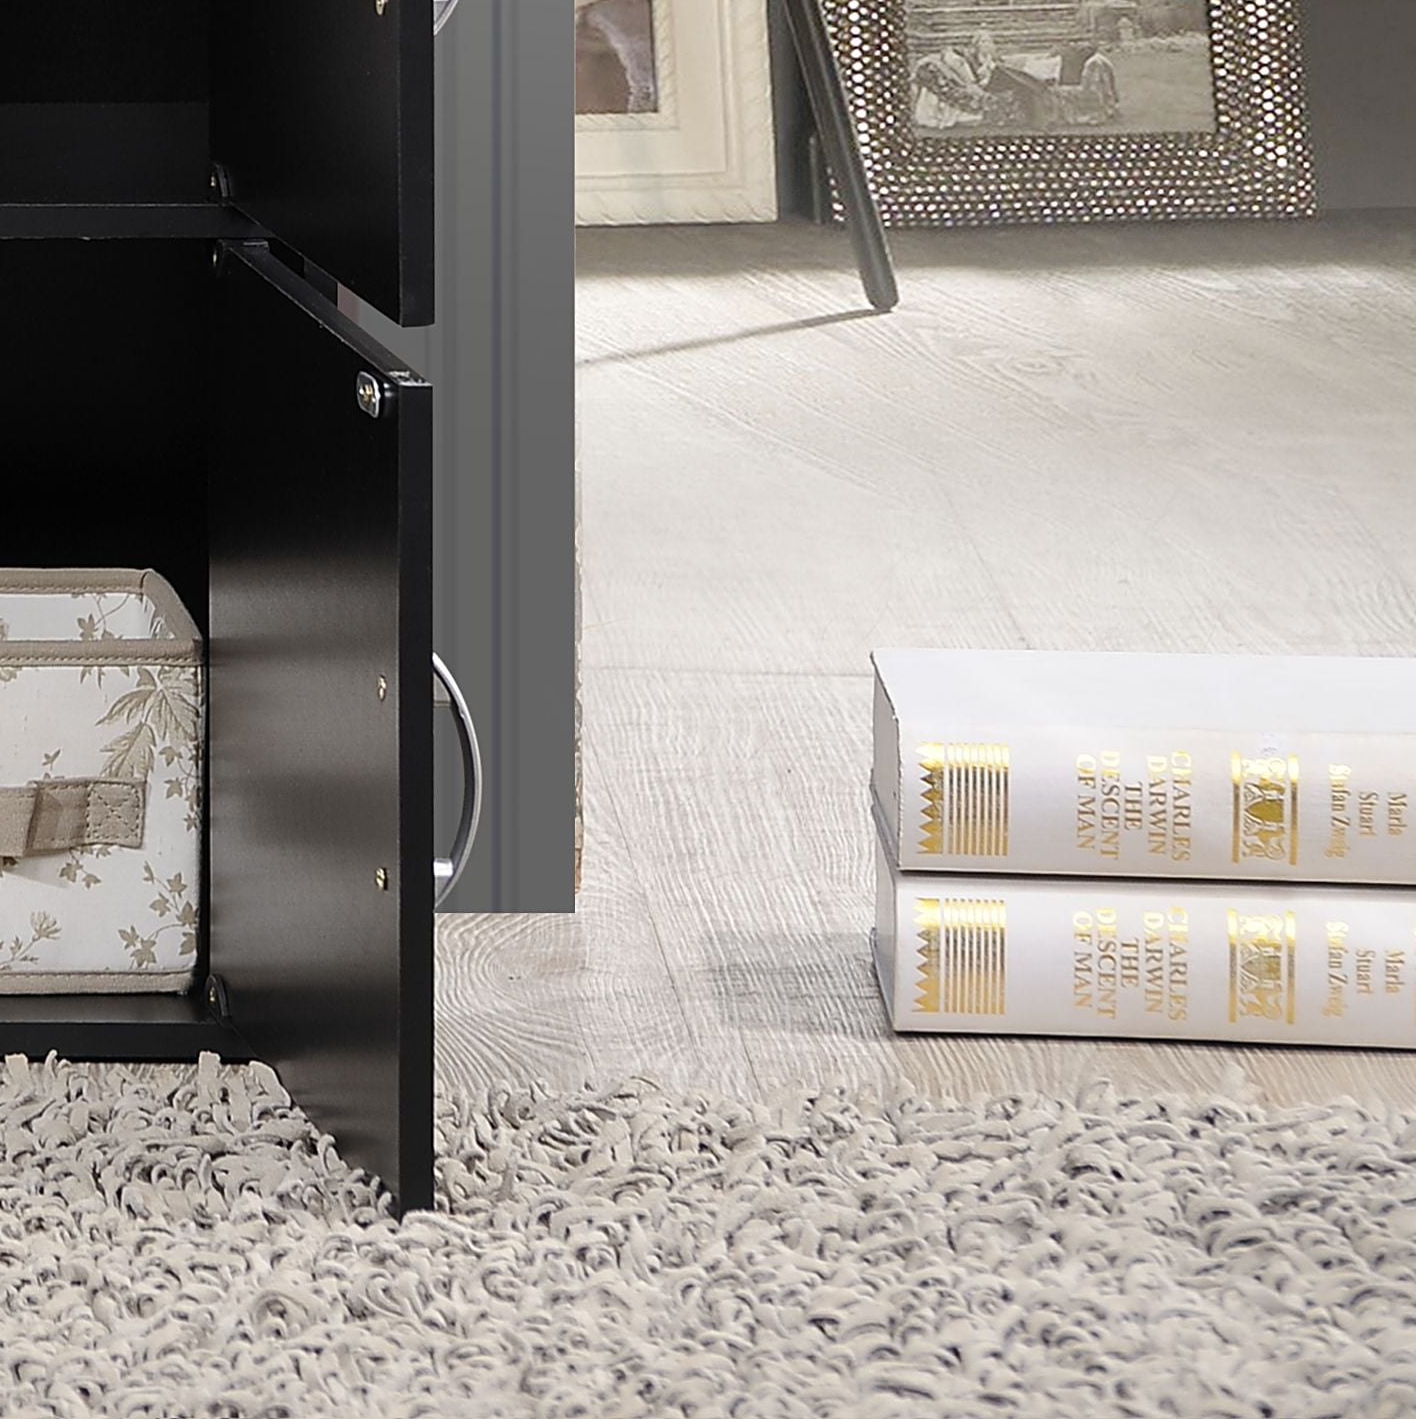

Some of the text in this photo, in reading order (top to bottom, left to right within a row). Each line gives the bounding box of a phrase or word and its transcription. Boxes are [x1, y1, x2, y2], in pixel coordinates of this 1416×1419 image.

[1076, 754, 1096, 850] OF MAN
[1100, 750, 1120, 861] DESCENT
[1124, 780, 1143, 831] THE
[1146, 755, 1167, 856] DARWIN
[1171, 749, 1192, 861] CHARLES
[1358, 790, 1379, 837] Stuart
[1073, 910, 1093, 1008] OF MAN
[1095, 906, 1116, 1019] DESCENT
[1120, 937, 1140, 989] THE
[1144, 911, 1164, 1014] DARWIN
[1167, 906, 1189, 1021] CHARLES
[1355, 948, 1377, 995] Stuart
